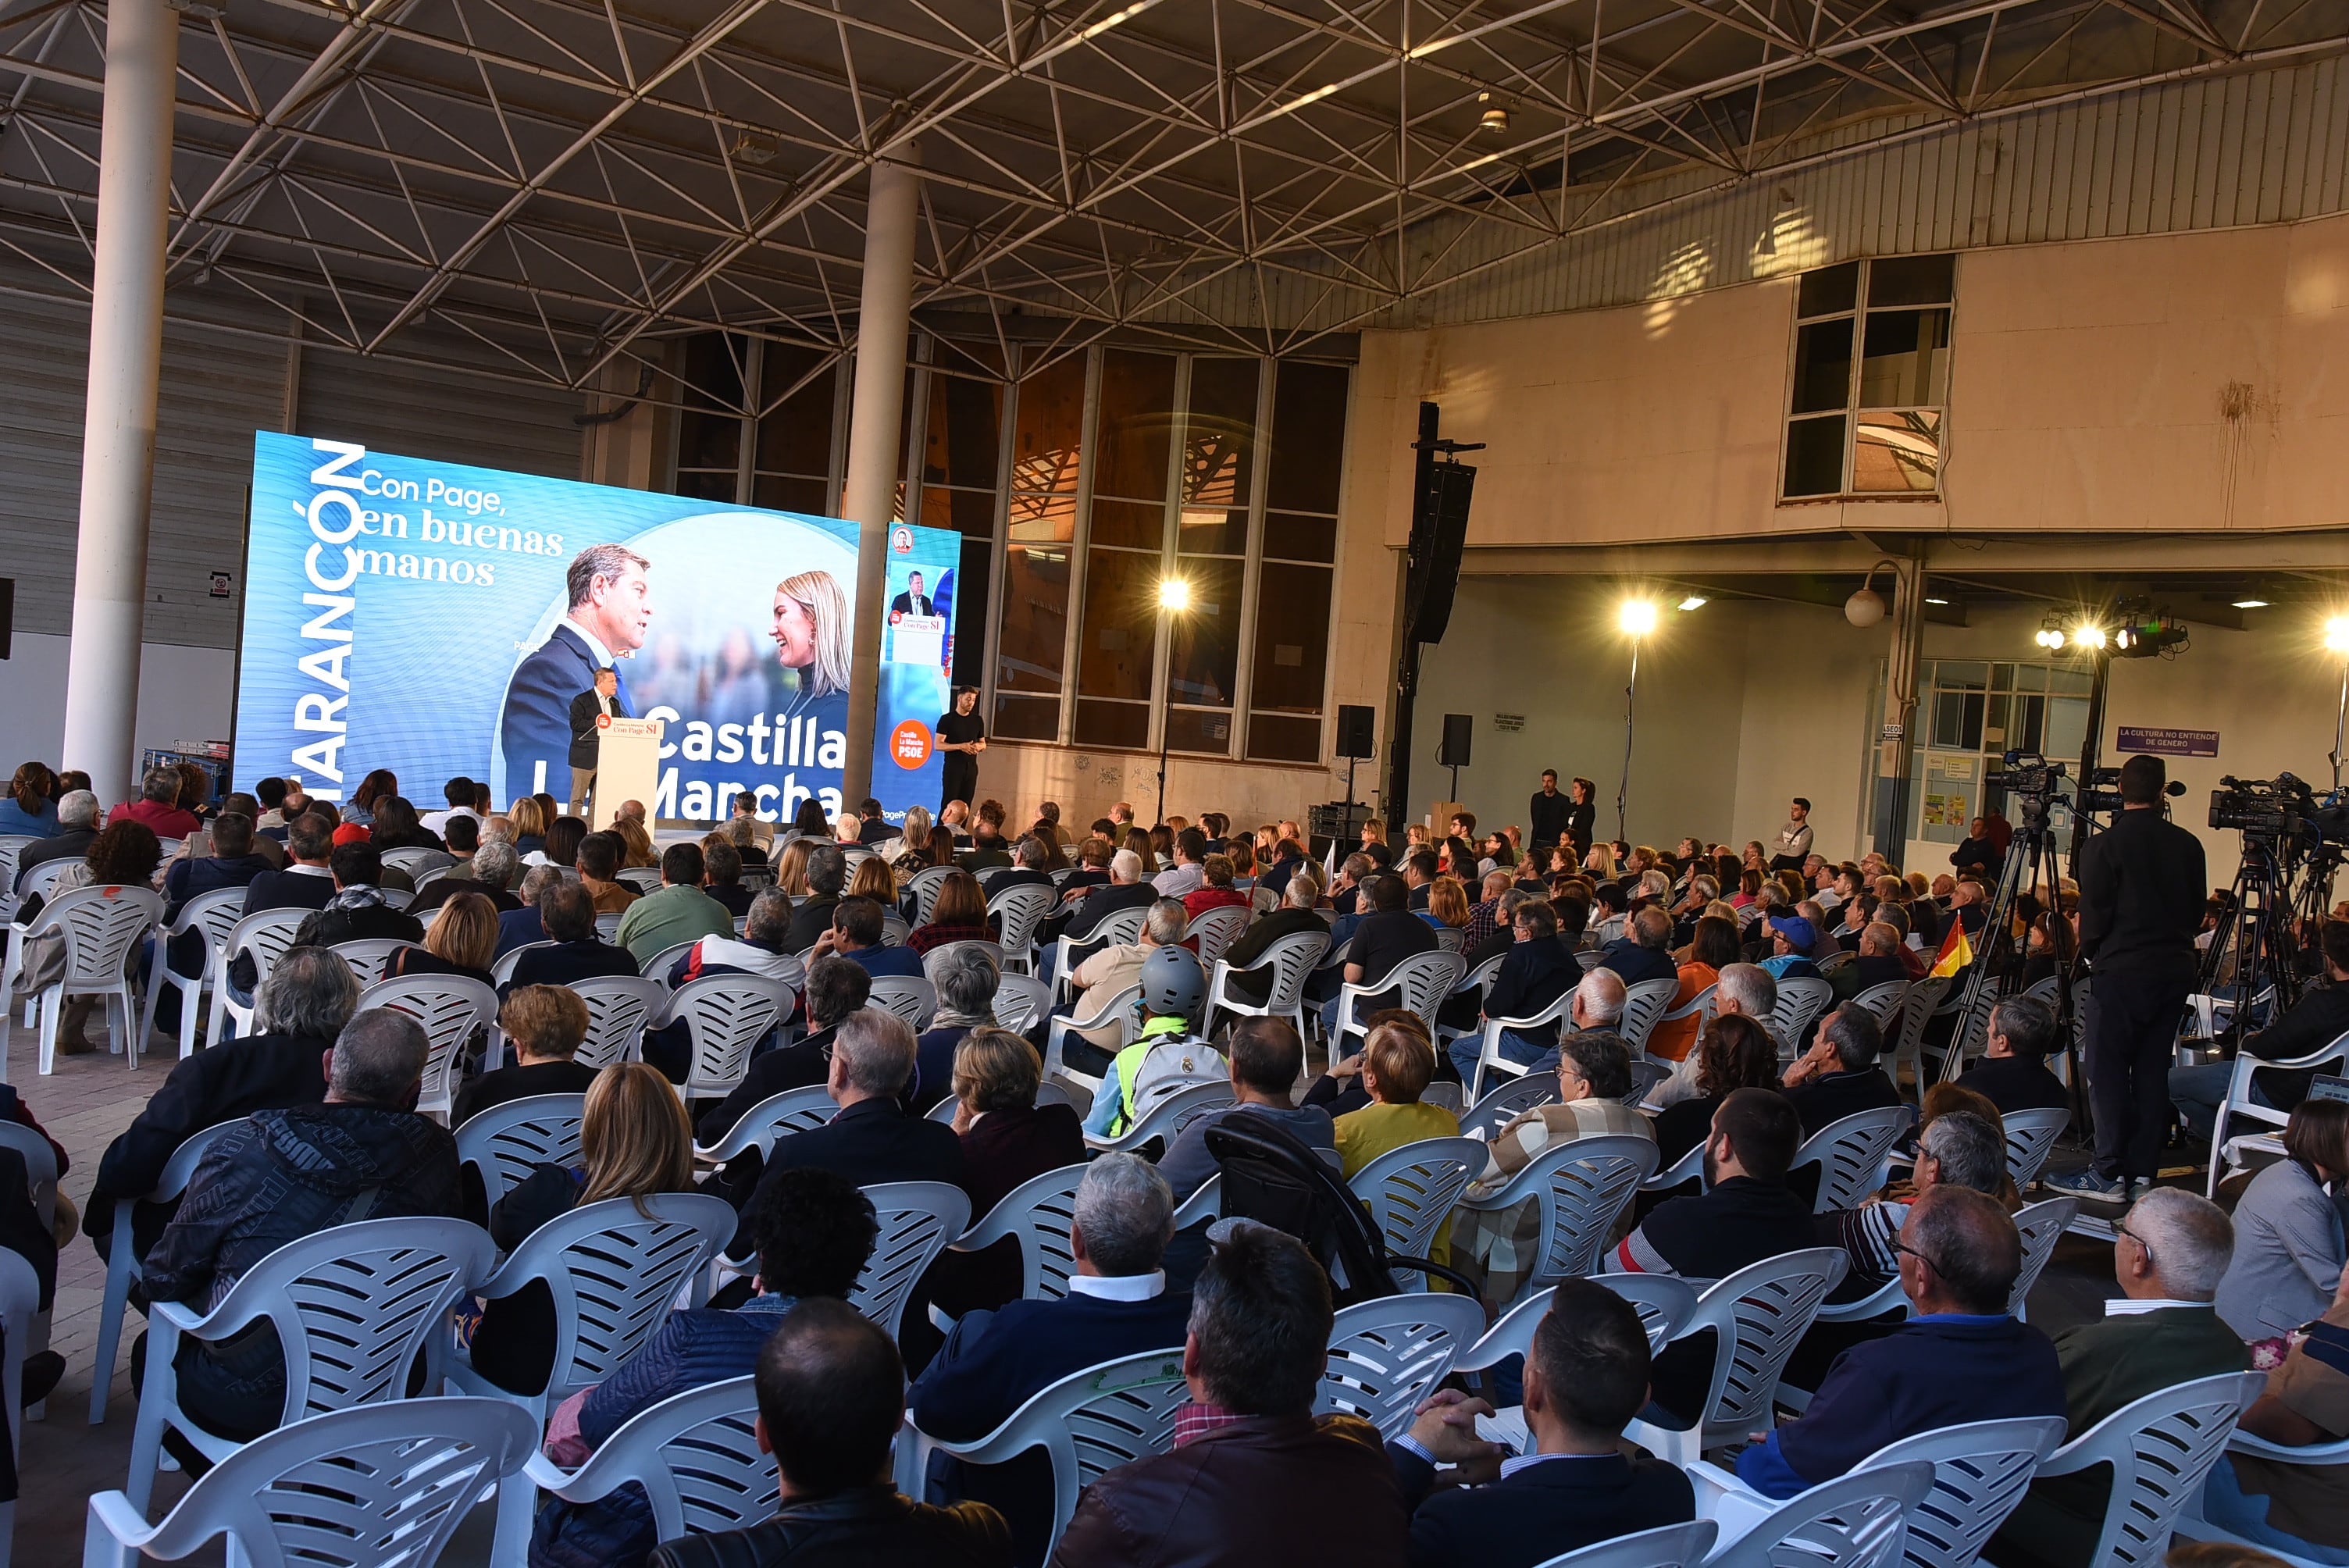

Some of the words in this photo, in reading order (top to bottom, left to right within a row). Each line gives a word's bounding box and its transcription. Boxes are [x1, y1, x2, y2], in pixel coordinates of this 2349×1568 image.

[362, 469, 419, 501] Con
[427, 478, 506, 517] Page,
[358, 510, 408, 539] en
[420, 509, 564, 557] buenas
[357, 549, 495, 586] manos
[898, 746, 923, 758] PSOE
[2130, 729, 2165, 738] CULTURA
[2178, 732, 2217, 741] ENTIENDE
